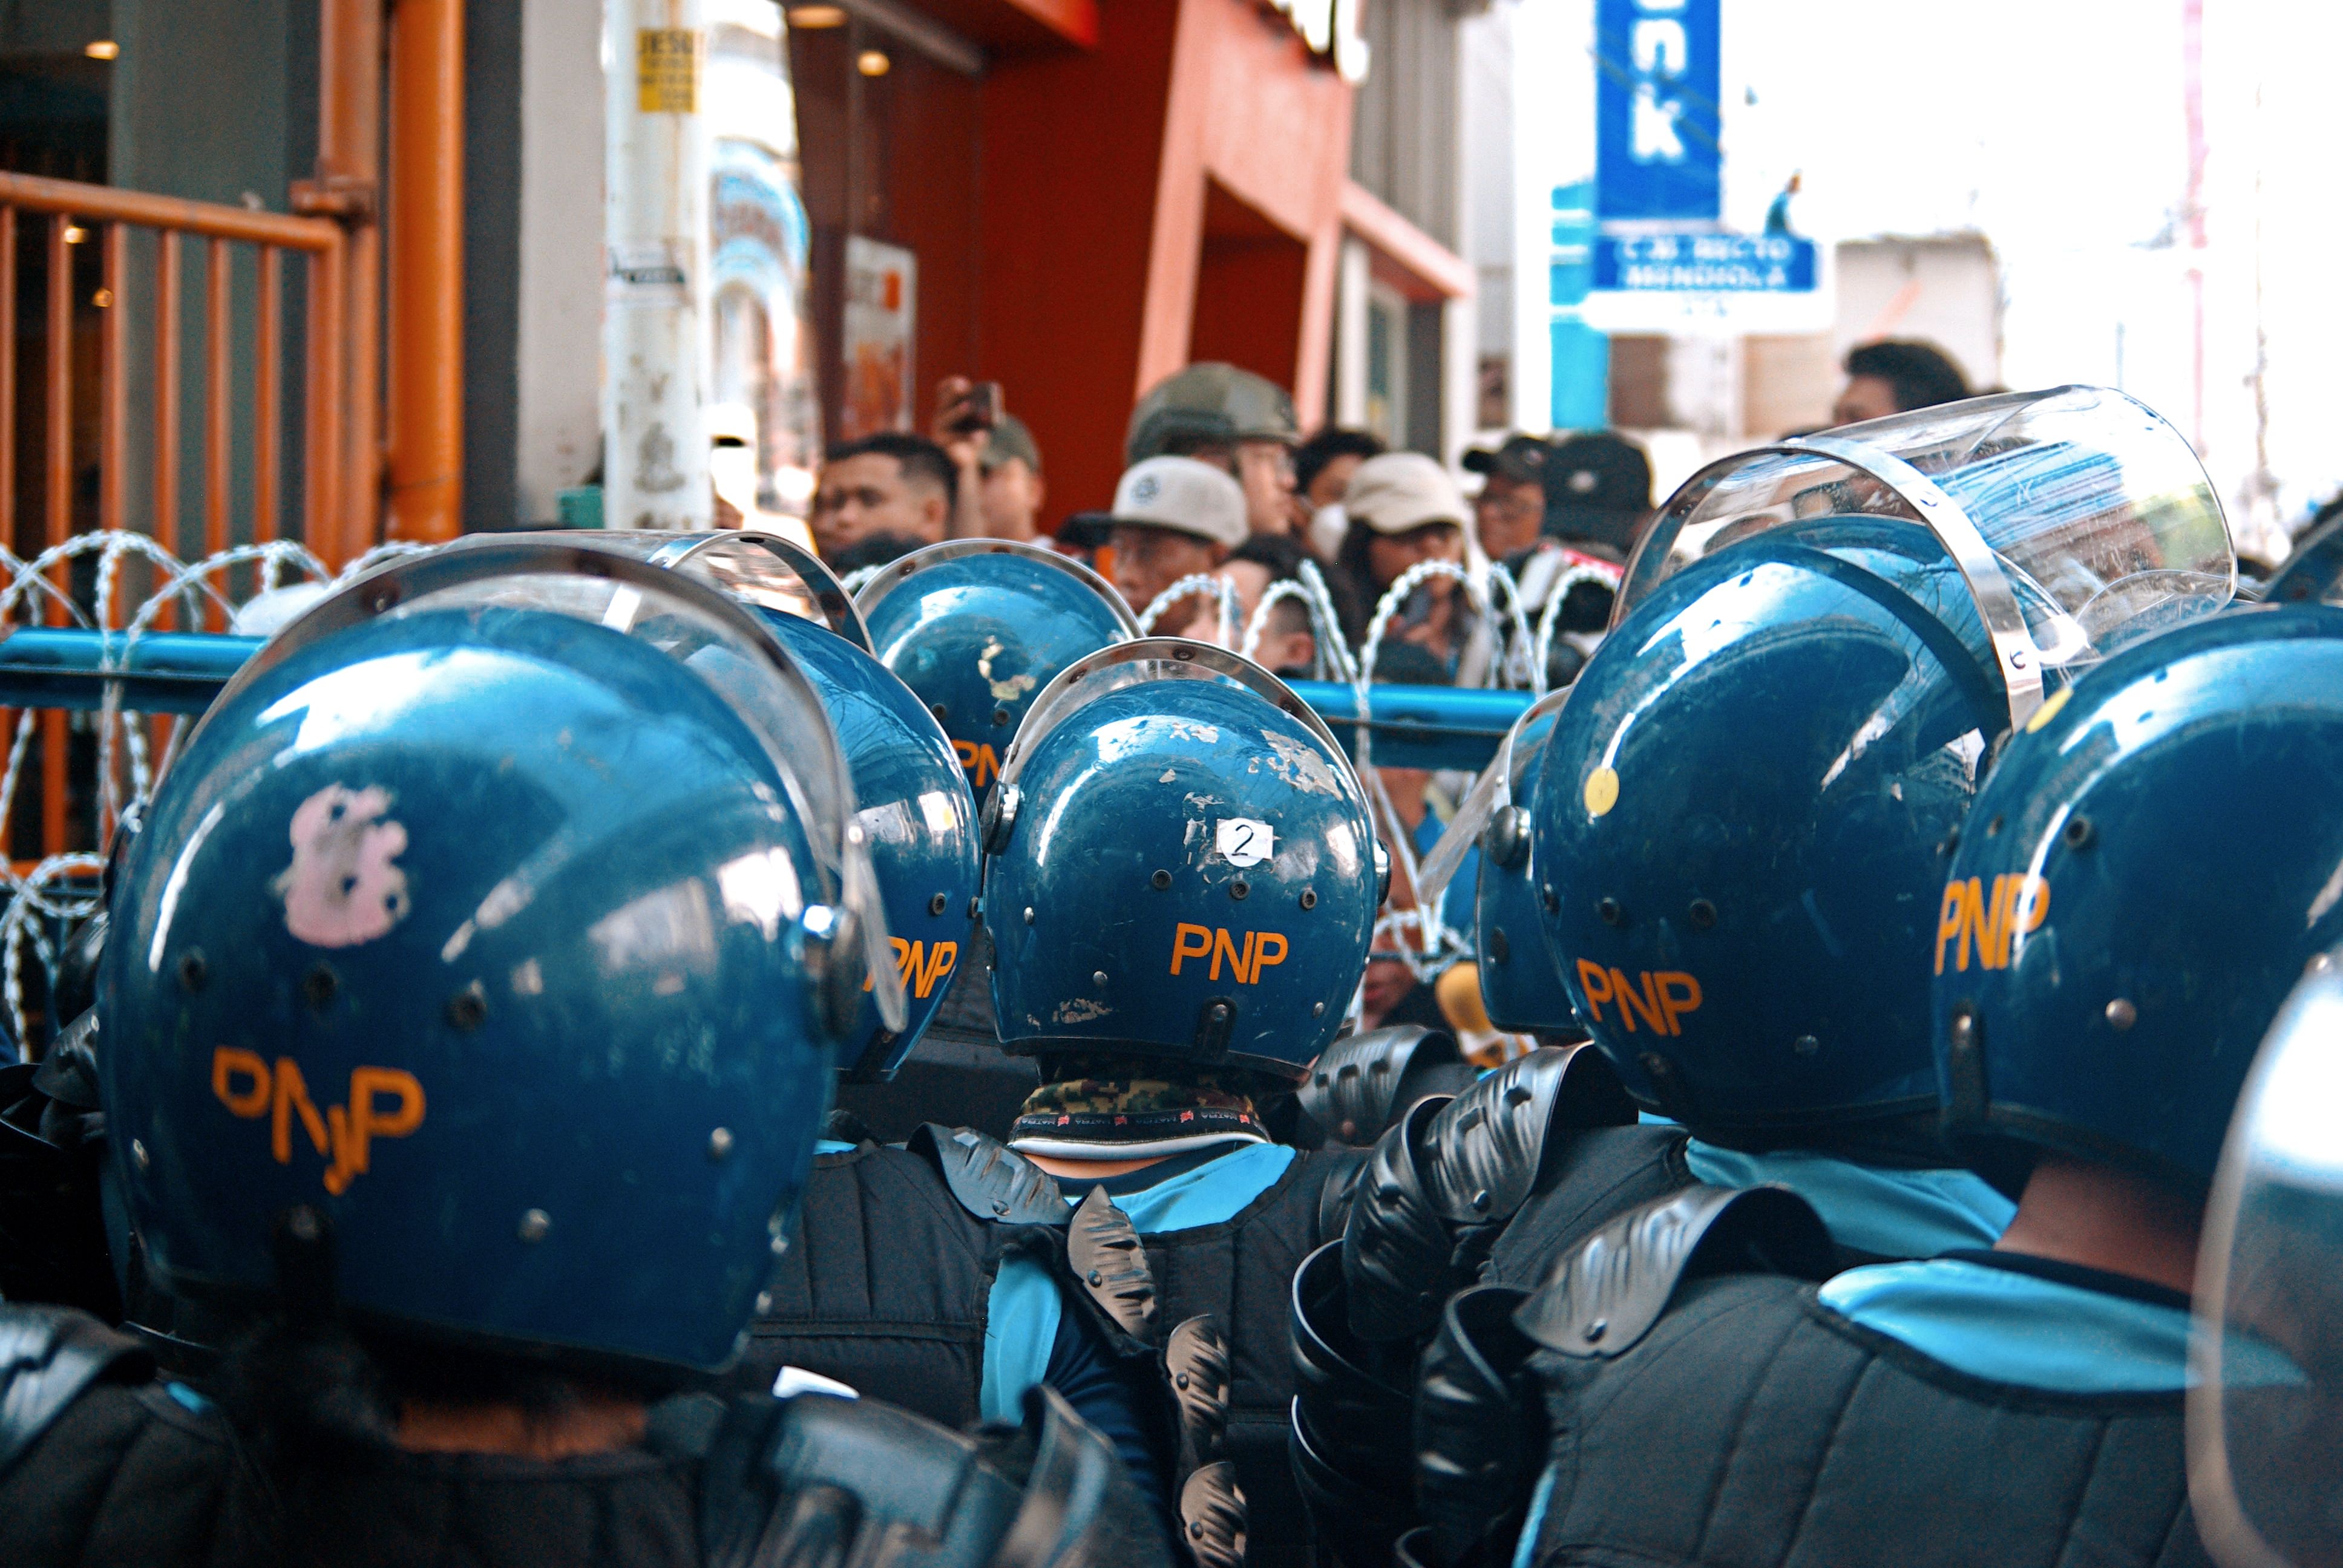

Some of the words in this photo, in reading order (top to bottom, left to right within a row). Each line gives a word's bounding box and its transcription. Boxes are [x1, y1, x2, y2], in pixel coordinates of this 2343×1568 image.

[1634, 0, 1686, 158] nk
[1231, 825, 1254, 856] 2
[1170, 923, 1289, 985] PNP
[1934, 873, 2051, 976] PNP
[1576, 958, 1703, 1037] PNP
